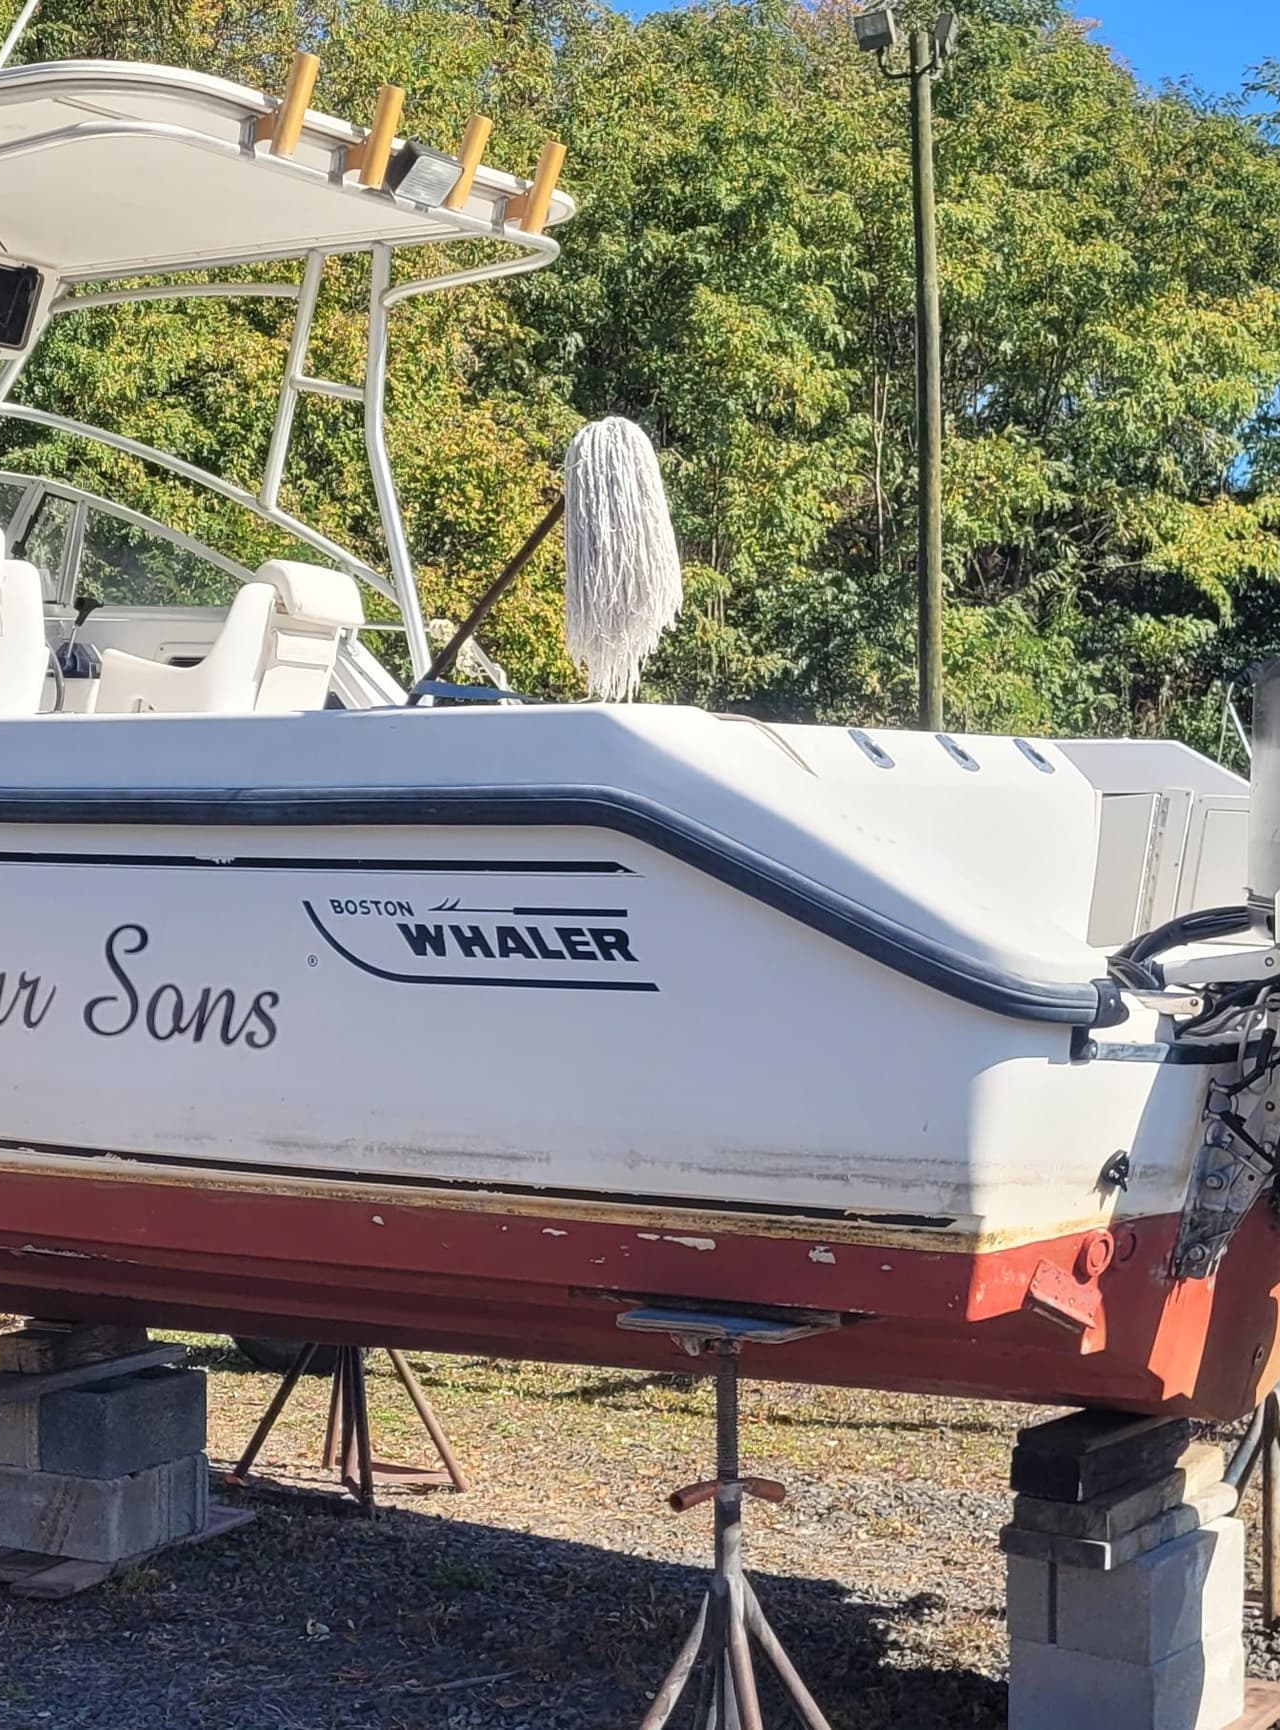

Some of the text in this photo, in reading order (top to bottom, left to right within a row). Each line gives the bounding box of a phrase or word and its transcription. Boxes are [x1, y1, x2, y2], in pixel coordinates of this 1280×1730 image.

[329, 898, 415, 918] BOSTON
[395, 922, 641, 963] WHALER
[83, 923, 281, 1050] Sons
